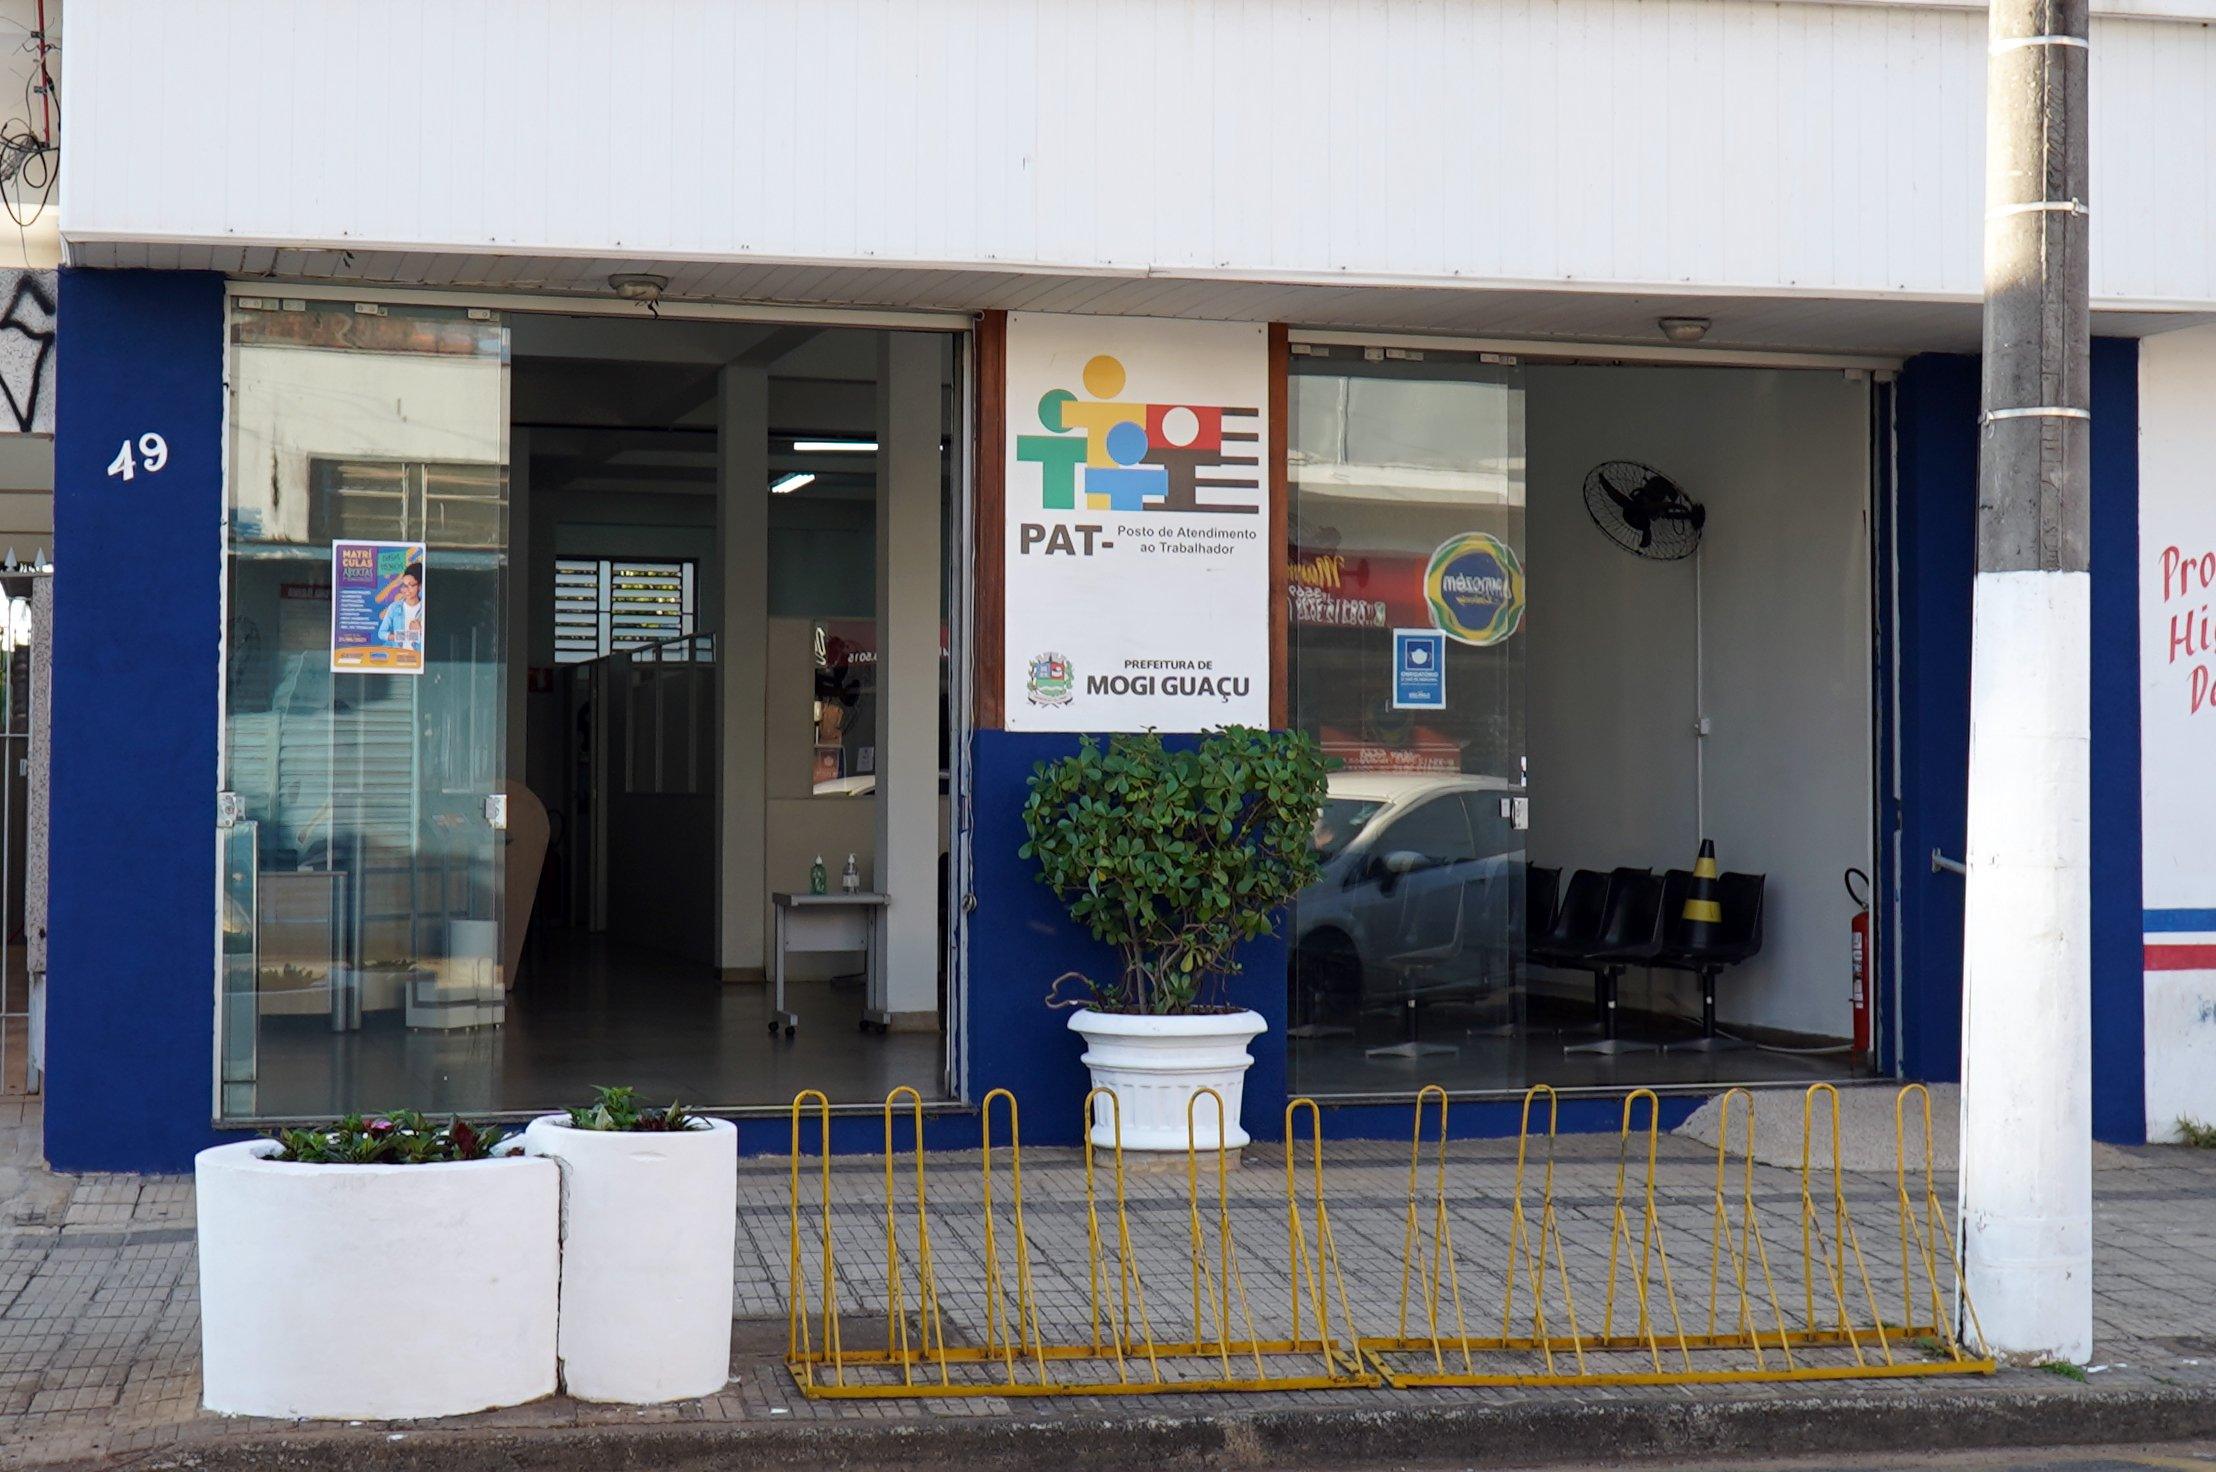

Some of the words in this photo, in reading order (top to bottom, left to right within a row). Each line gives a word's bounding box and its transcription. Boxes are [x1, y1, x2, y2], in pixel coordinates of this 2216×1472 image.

[107, 432, 168, 481] 49
[1117, 524, 1156, 538] Posto
[1158, 526, 1174, 538] de
[1176, 527, 1259, 541] Atendimento
[1140, 543, 1157, 553] ao
[1159, 542, 1237, 555] Trabalhador
[2168, 603, 2216, 666] Hi
[1124, 660, 1197, 670] PREFEITURA
[1198, 660, 1214, 671] DE
[1086, 675, 1156, 697] MOGI
[1161, 676, 1250, 704] GUAÇU
